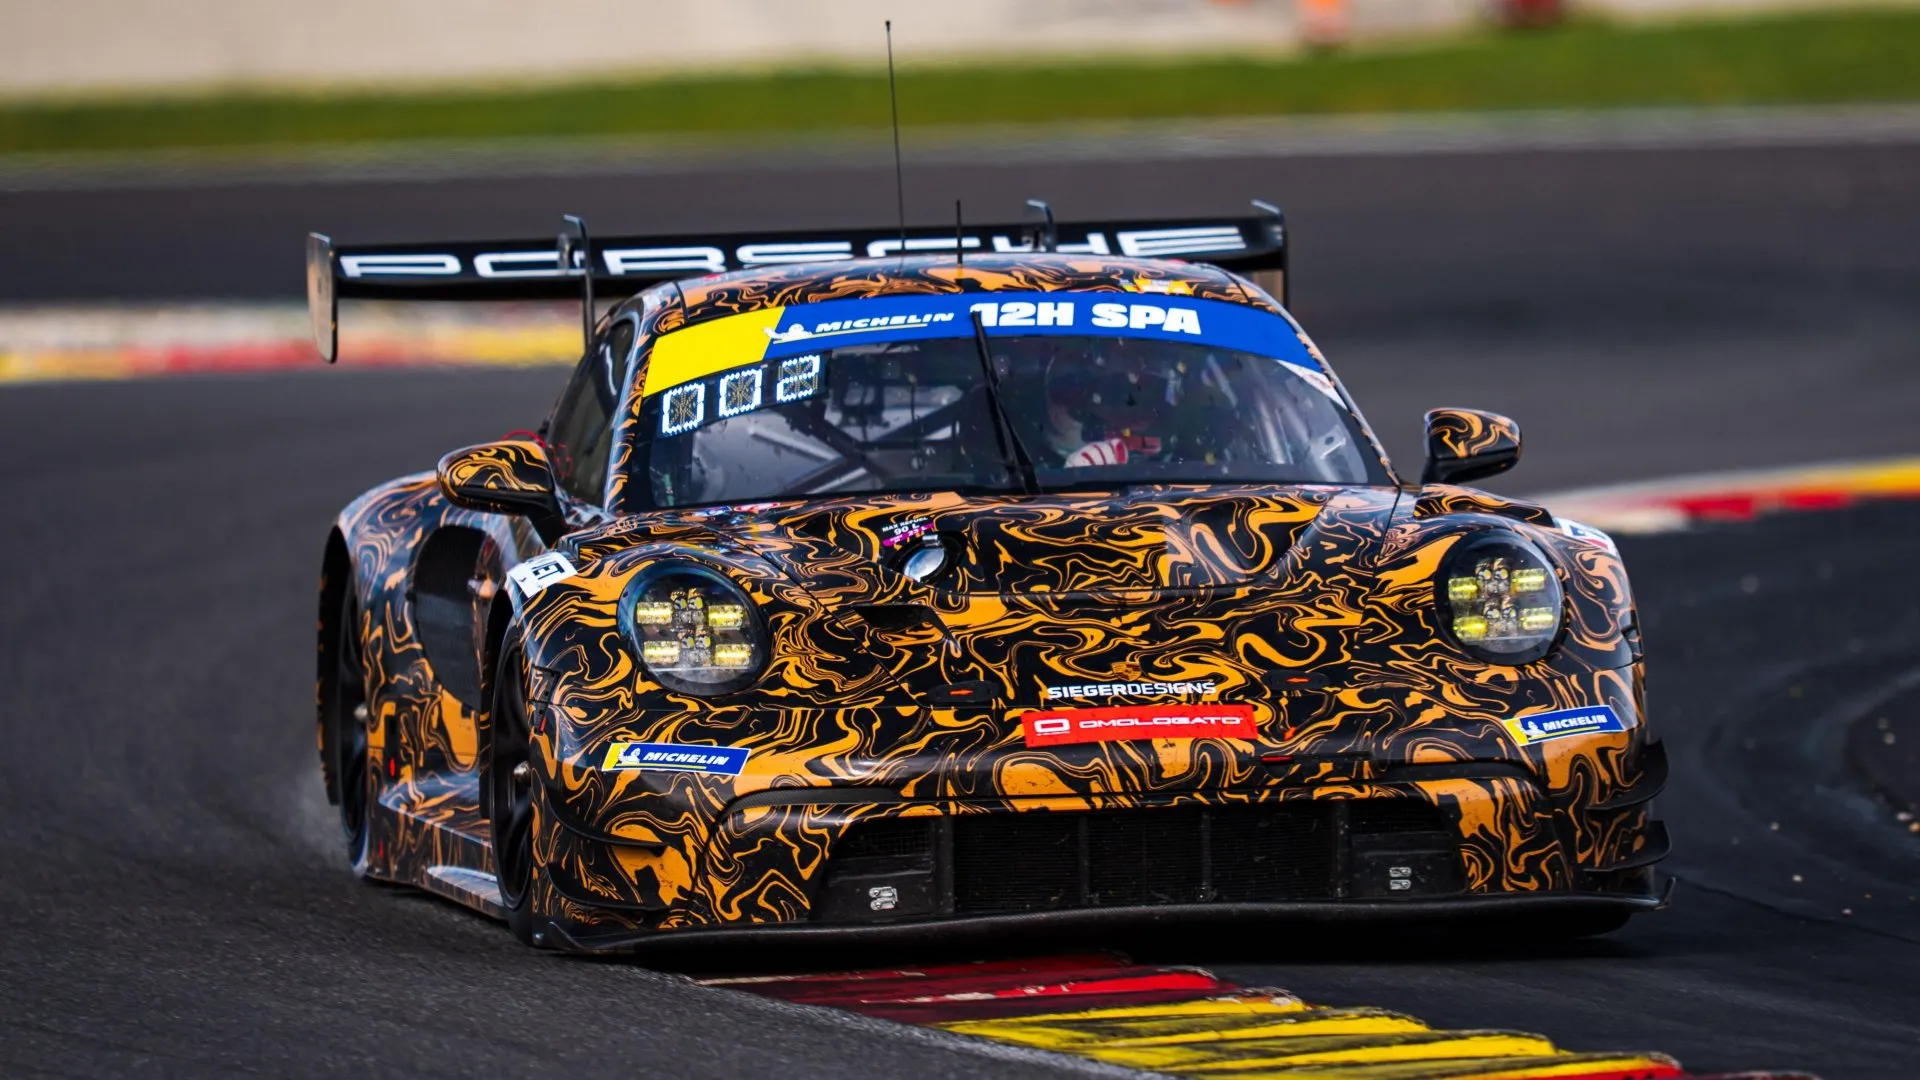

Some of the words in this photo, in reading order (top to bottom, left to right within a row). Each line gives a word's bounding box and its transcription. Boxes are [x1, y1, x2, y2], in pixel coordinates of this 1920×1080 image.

[340, 227, 1246, 278] PORSCHE
[815, 312, 955, 333] MICHELIN
[970, 302, 1074, 328] 12H
[1091, 302, 1202, 335] SPA
[882, 523, 899, 532] MAX
[900, 516, 929, 526] REFUEL
[894, 525, 909, 536] 90
[1047, 682, 1217, 699] SIEGERDESIGNS
[1078, 716, 1241, 729] OMOLOGATO
[1543, 714, 1608, 732] MICHELIN
[643, 752, 730, 765] MICHELIN
